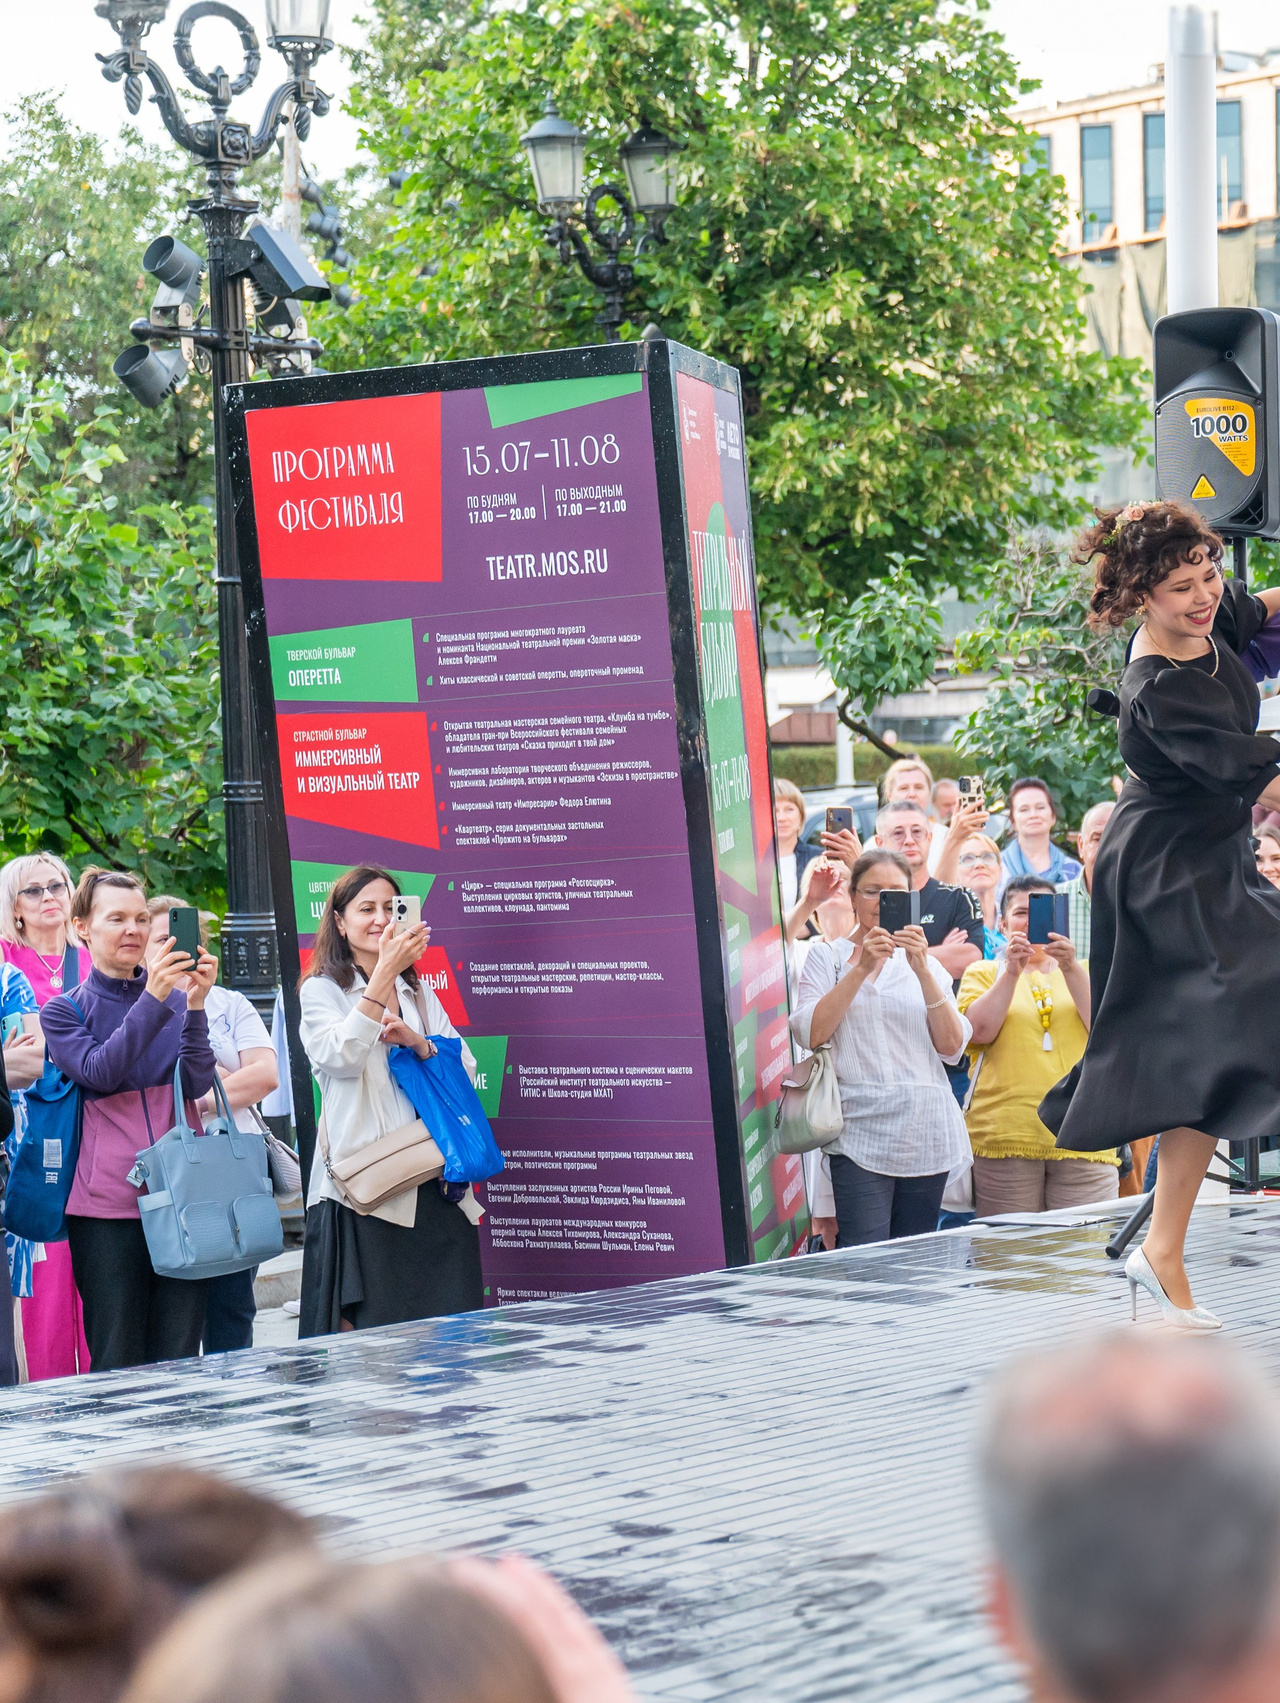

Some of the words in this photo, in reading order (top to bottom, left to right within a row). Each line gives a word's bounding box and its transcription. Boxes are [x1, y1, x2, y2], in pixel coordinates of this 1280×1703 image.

[1191, 413, 1248, 438] 1000
[1218, 434, 1249, 443] WATTS
[272, 441, 394, 482] ПРОГРАММА
[554, 488, 567, 501] ПО
[569, 484, 622, 500] ВЫХОДНЫМ
[467, 495, 479, 508] ПО
[481, 492, 517, 508] БУДНЯМ
[278, 491, 403, 533] ФЕСТИВАЛЯ
[468, 510, 493, 523] 17.00
[509, 506, 536, 520] 20.00
[556, 502, 582, 516] 17.00
[599, 499, 626, 513] 21.00
[485, 548, 607, 580] TEATR.MOS.RU
[476, 630, 509, 641] программа
[557, 625, 585, 635] лауреата
[442, 644, 474, 653] номинанта
[561, 637, 585, 647] премии
[286, 647, 322, 660] ТВЕРСКОЙ
[323, 646, 355, 660] БУЛЬВАР
[438, 656, 462, 665] Алексея
[464, 654, 497, 664] Франдетти
[700, 622, 738, 708] БУЛЬВАР
[288, 668, 341, 686] ОПЕРЕТТА
[439, 675, 455, 684] Хиты
[504, 670, 536, 681] советской
[612, 666, 644, 676] променад
[443, 720, 472, 731] Открытая
[513, 717, 548, 727] мастерская
[549, 715, 581, 725] семейного
[293, 729, 333, 742] СТРАСТНОЙ
[334, 728, 366, 741] БУЛЬВАР
[444, 732, 480, 742] обладателя
[481, 731, 509, 741] гран-при
[560, 727, 594, 737] фестиваля
[595, 726, 626, 734] семейных
[495, 742, 519, 752] театров
[547, 740, 575, 749] приходит
[583, 738, 597, 746] твой
[294, 744, 381, 767] ИММЕРСИВНЫЙ
[297, 777, 305, 792] И
[308, 771, 384, 793] ВИЗУАЛЬНЫЙ
[387, 772, 419, 789] ТЕАТР
[527, 776, 551, 785] актеров
[558, 774, 595, 784] музыкантов
[495, 801, 512, 810] театр
[559, 798, 583, 807] Федора
[584, 797, 611, 805] Елютина
[495, 824, 513, 833] серия
[567, 821, 604, 830] застольных
[455, 835, 490, 845] спектаклей
[309, 881, 335, 894] ЦВЕТН
[534, 880, 567, 889] программа
[503, 892, 533, 901] цирковых
[564, 891, 591, 900] уличных
[311, 901, 327, 920] ЦИ
[536, 903, 569, 911] пантомима
[469, 962, 498, 971] Создание
[537, 961, 570, 971] декораций
[470, 975, 499, 983] открытые
[519, 985, 549, 994] открытые
[550, 985, 573, 993] показы
[518, 1065, 548, 1074] Выставка
[591, 1066, 618, 1074] костюма
[666, 1066, 693, 1074] макетов
[559, 1078, 586, 1087] институт
[631, 1078, 662, 1087] искусства
[520, 1088, 540, 1097] ГИТИС
[597, 1151, 631, 1159] программы
[674, 1151, 693, 1160] звезд
[563, 1162, 597, 1170] программы
